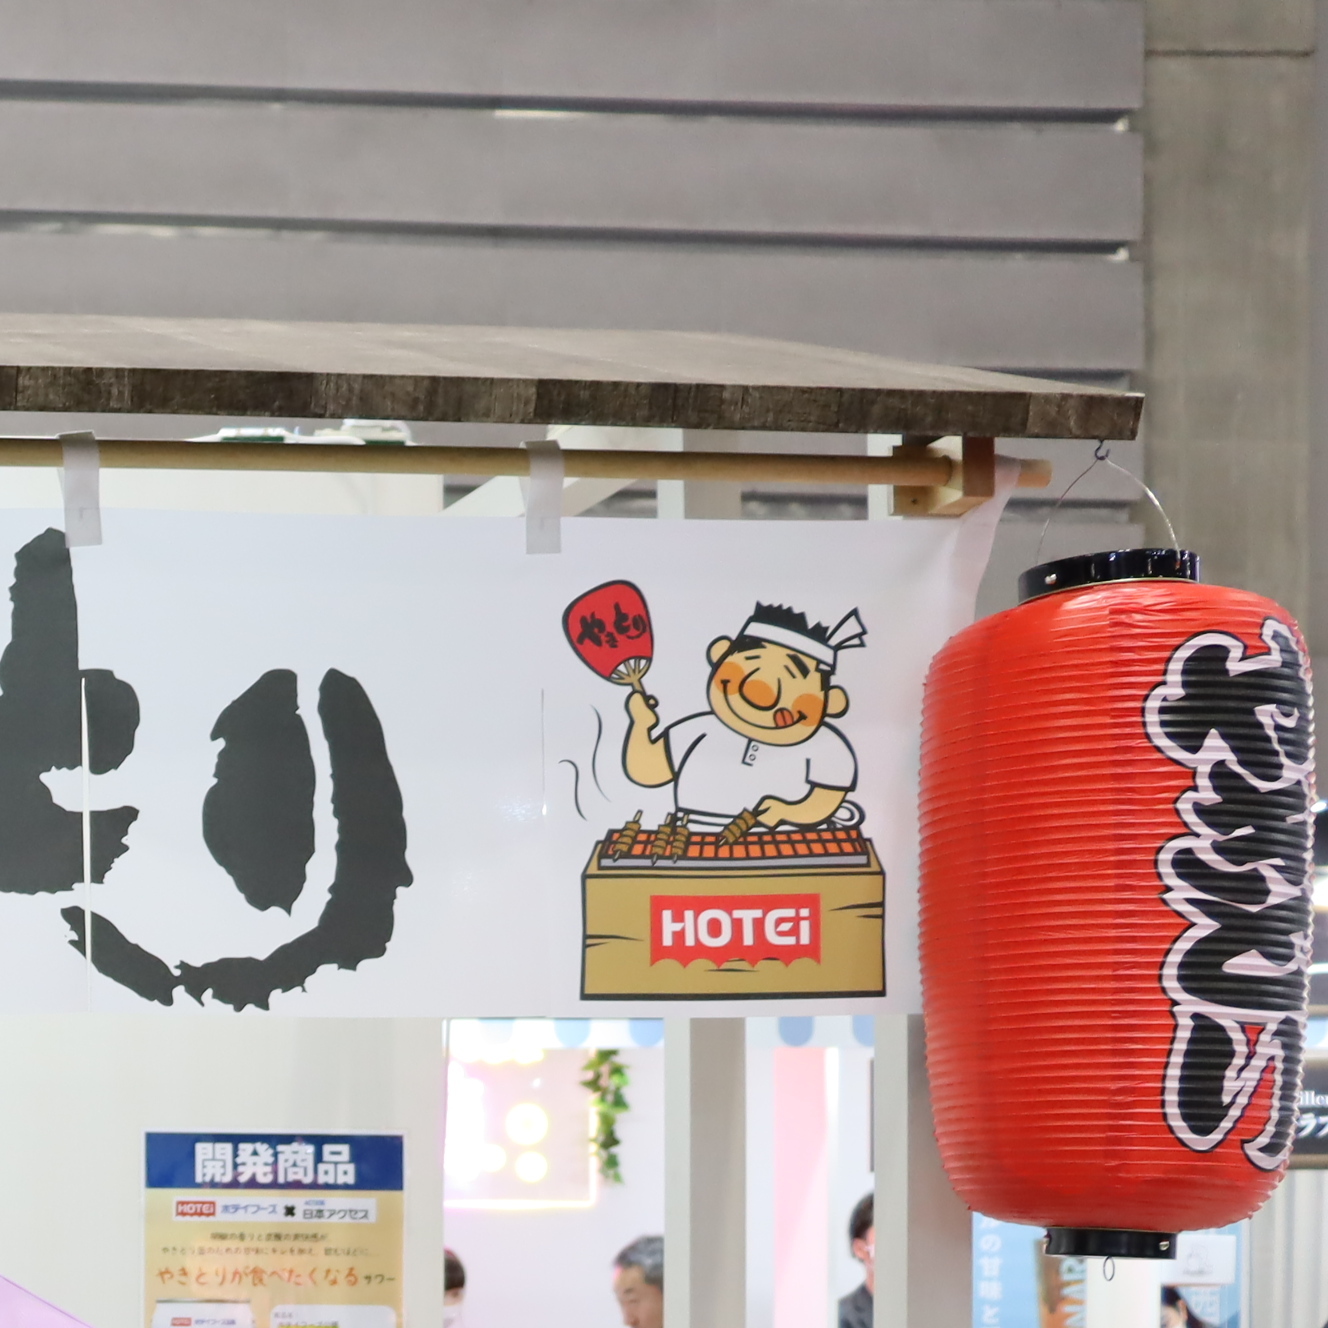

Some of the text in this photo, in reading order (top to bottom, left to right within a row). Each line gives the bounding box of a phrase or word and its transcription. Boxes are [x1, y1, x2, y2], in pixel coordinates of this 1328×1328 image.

[575, 602, 647, 649] やきとり
[194, 1141, 356, 1186] 開発商品
[220, 1203, 278, 1215] ホテイフーズ
[302, 1207, 370, 1220] 日本アクセス
[156, 1265, 396, 1287] やきとりが食べたくなる サワー
